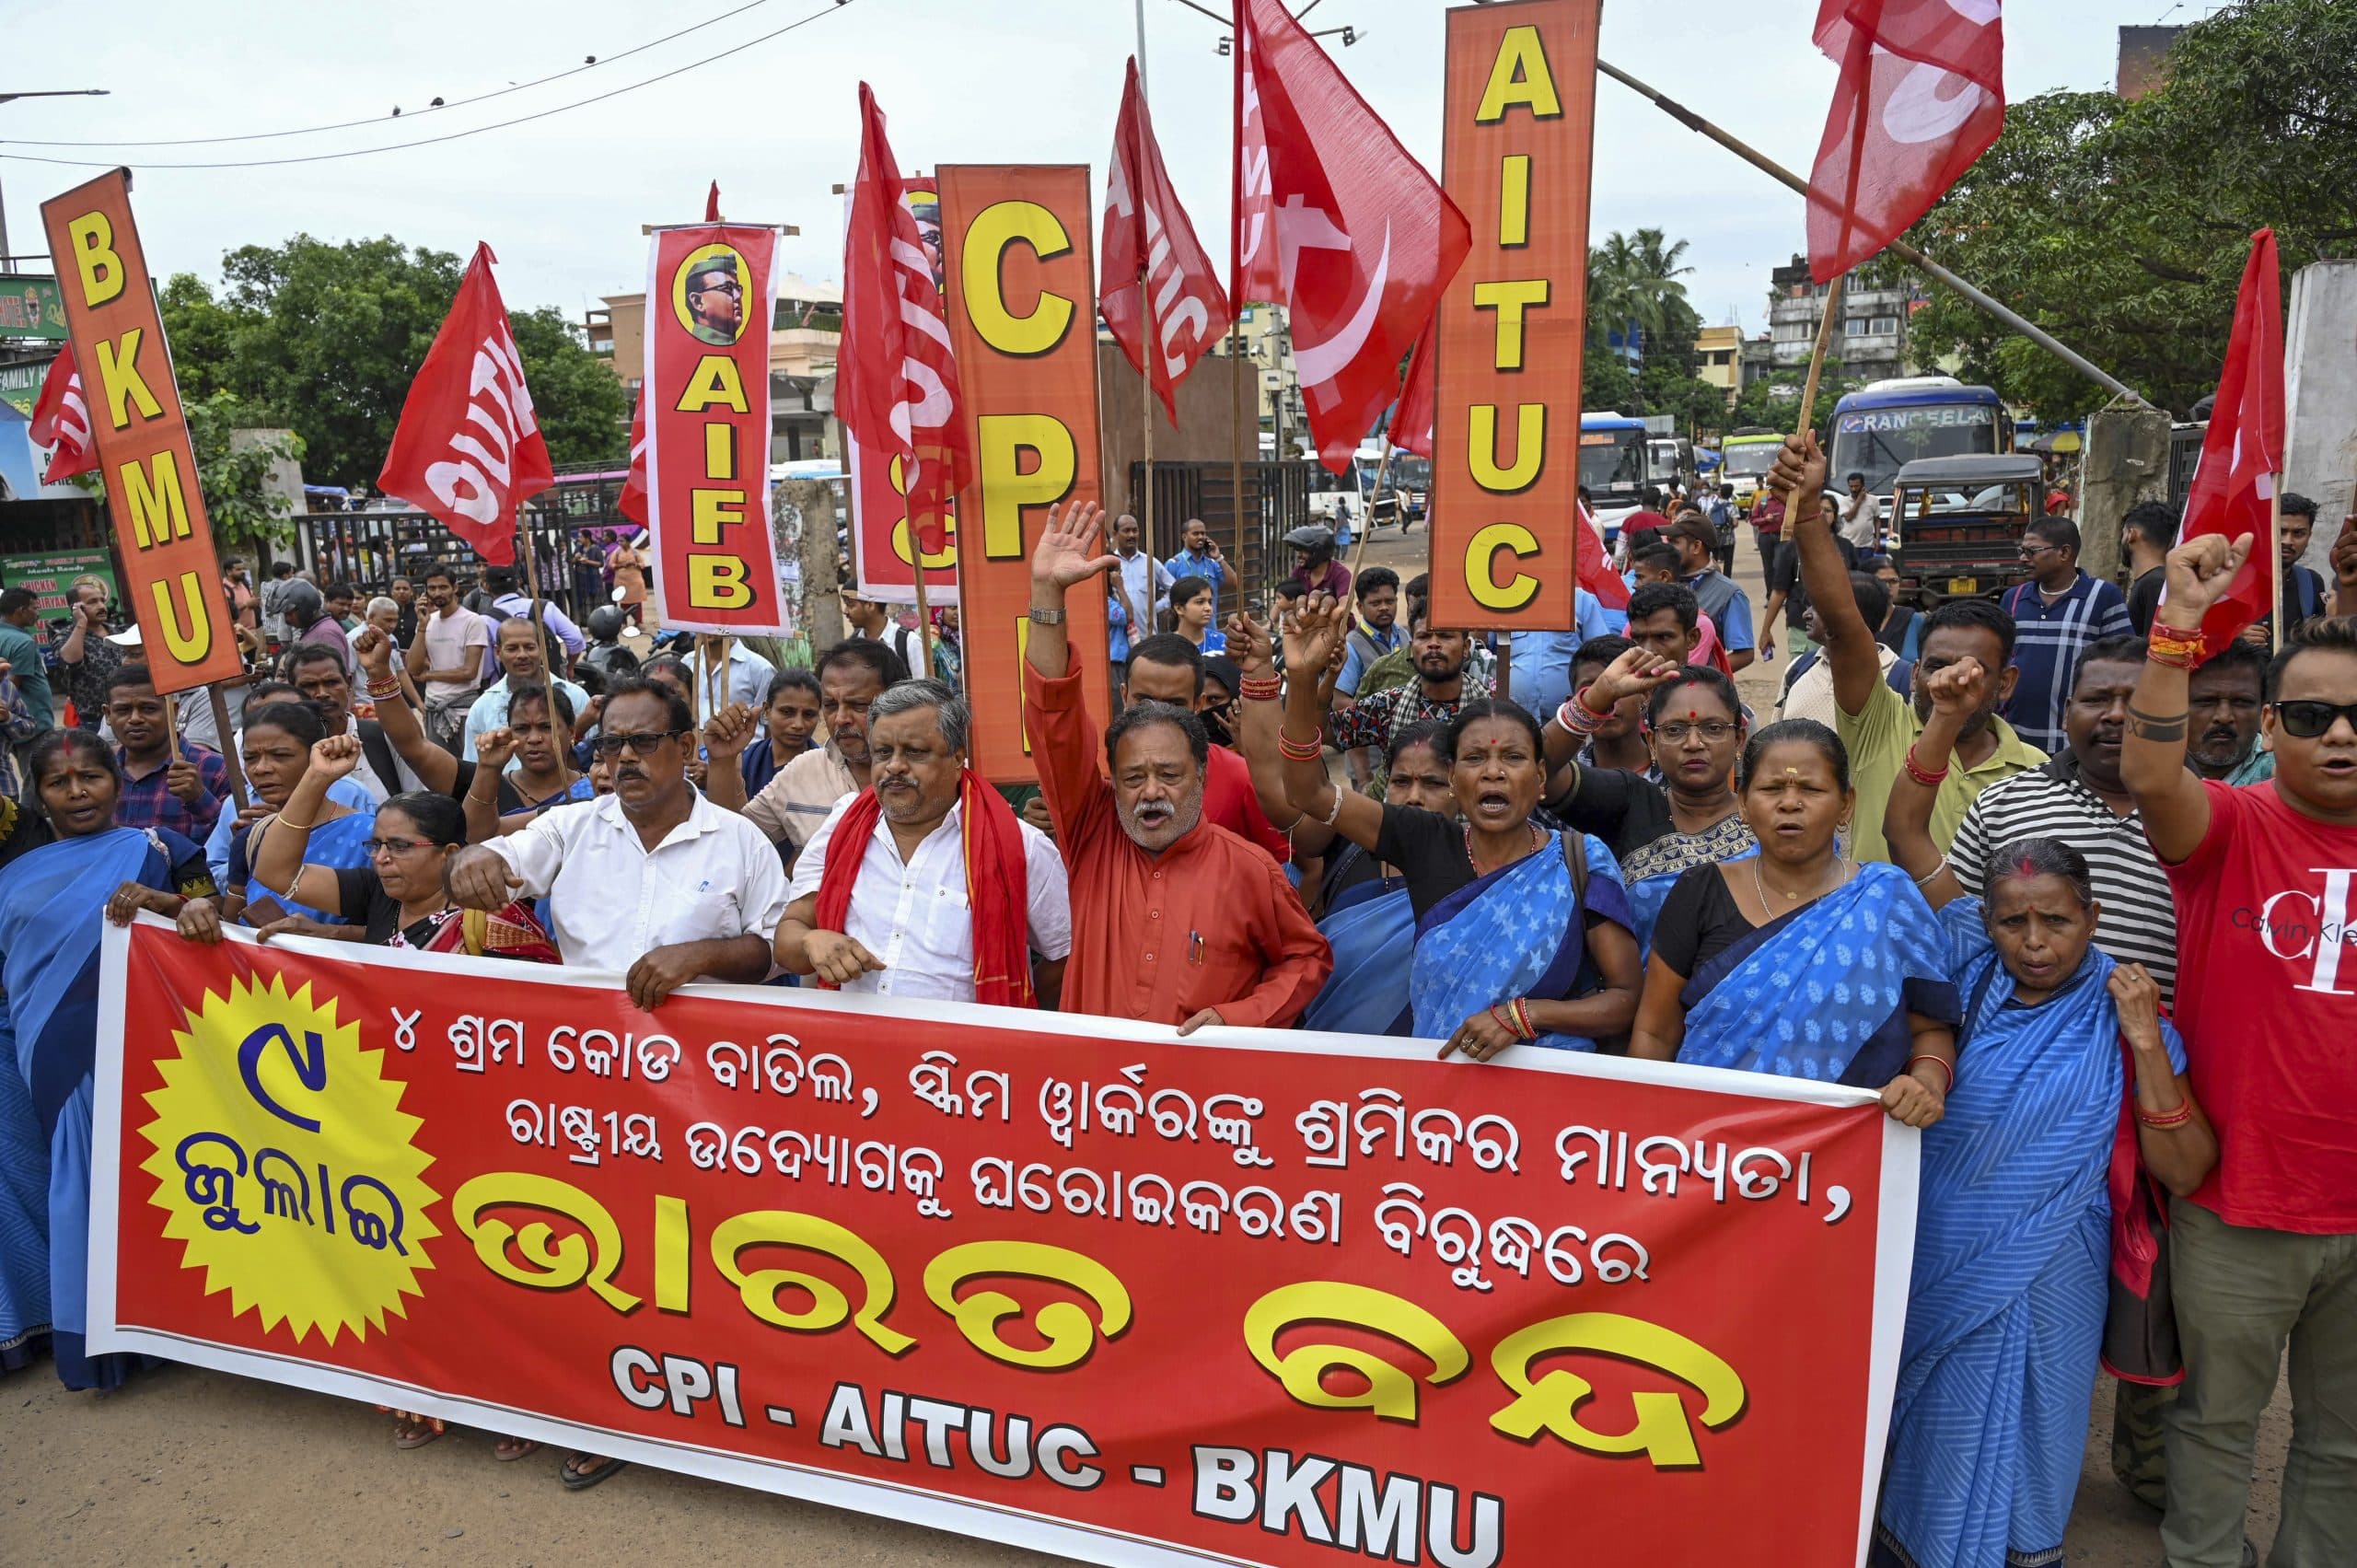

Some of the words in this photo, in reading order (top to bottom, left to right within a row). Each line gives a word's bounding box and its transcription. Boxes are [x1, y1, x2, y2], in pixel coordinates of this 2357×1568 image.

[1465, 26, 1563, 610] AITUC
[69, 211, 211, 663] BKMU
[678, 355, 752, 610] AIFB
[2232, 907, 2309, 940] Calvin
[175, 1132, 408, 1255] ଜୁଲାଇ
[390, 1006, 423, 1051] ୪
[447, 1015, 524, 1072] ଶ୍ରମ
[548, 1026, 682, 1082] କୋଡ
[706, 1033, 878, 1117] ବାତିଲ,
[909, 1050, 1009, 1121] ସ୍କିମ
[1295, 1087, 1520, 1172] ଶ୍ରମିକର
[1555, 1125, 1852, 1222] ମାନ୍ୟତା,
[970, 1156, 1341, 1243] ଘରୋଇକରଣ
[452, 1172, 1132, 1367] ଭାରତ
[1243, 1282, 1746, 1466] ବନ୍ଦ
[611, 1347, 744, 1426] CPI
[821, 1384, 1103, 1488] AITUC
[1193, 1446, 1500, 1568] BKMU
